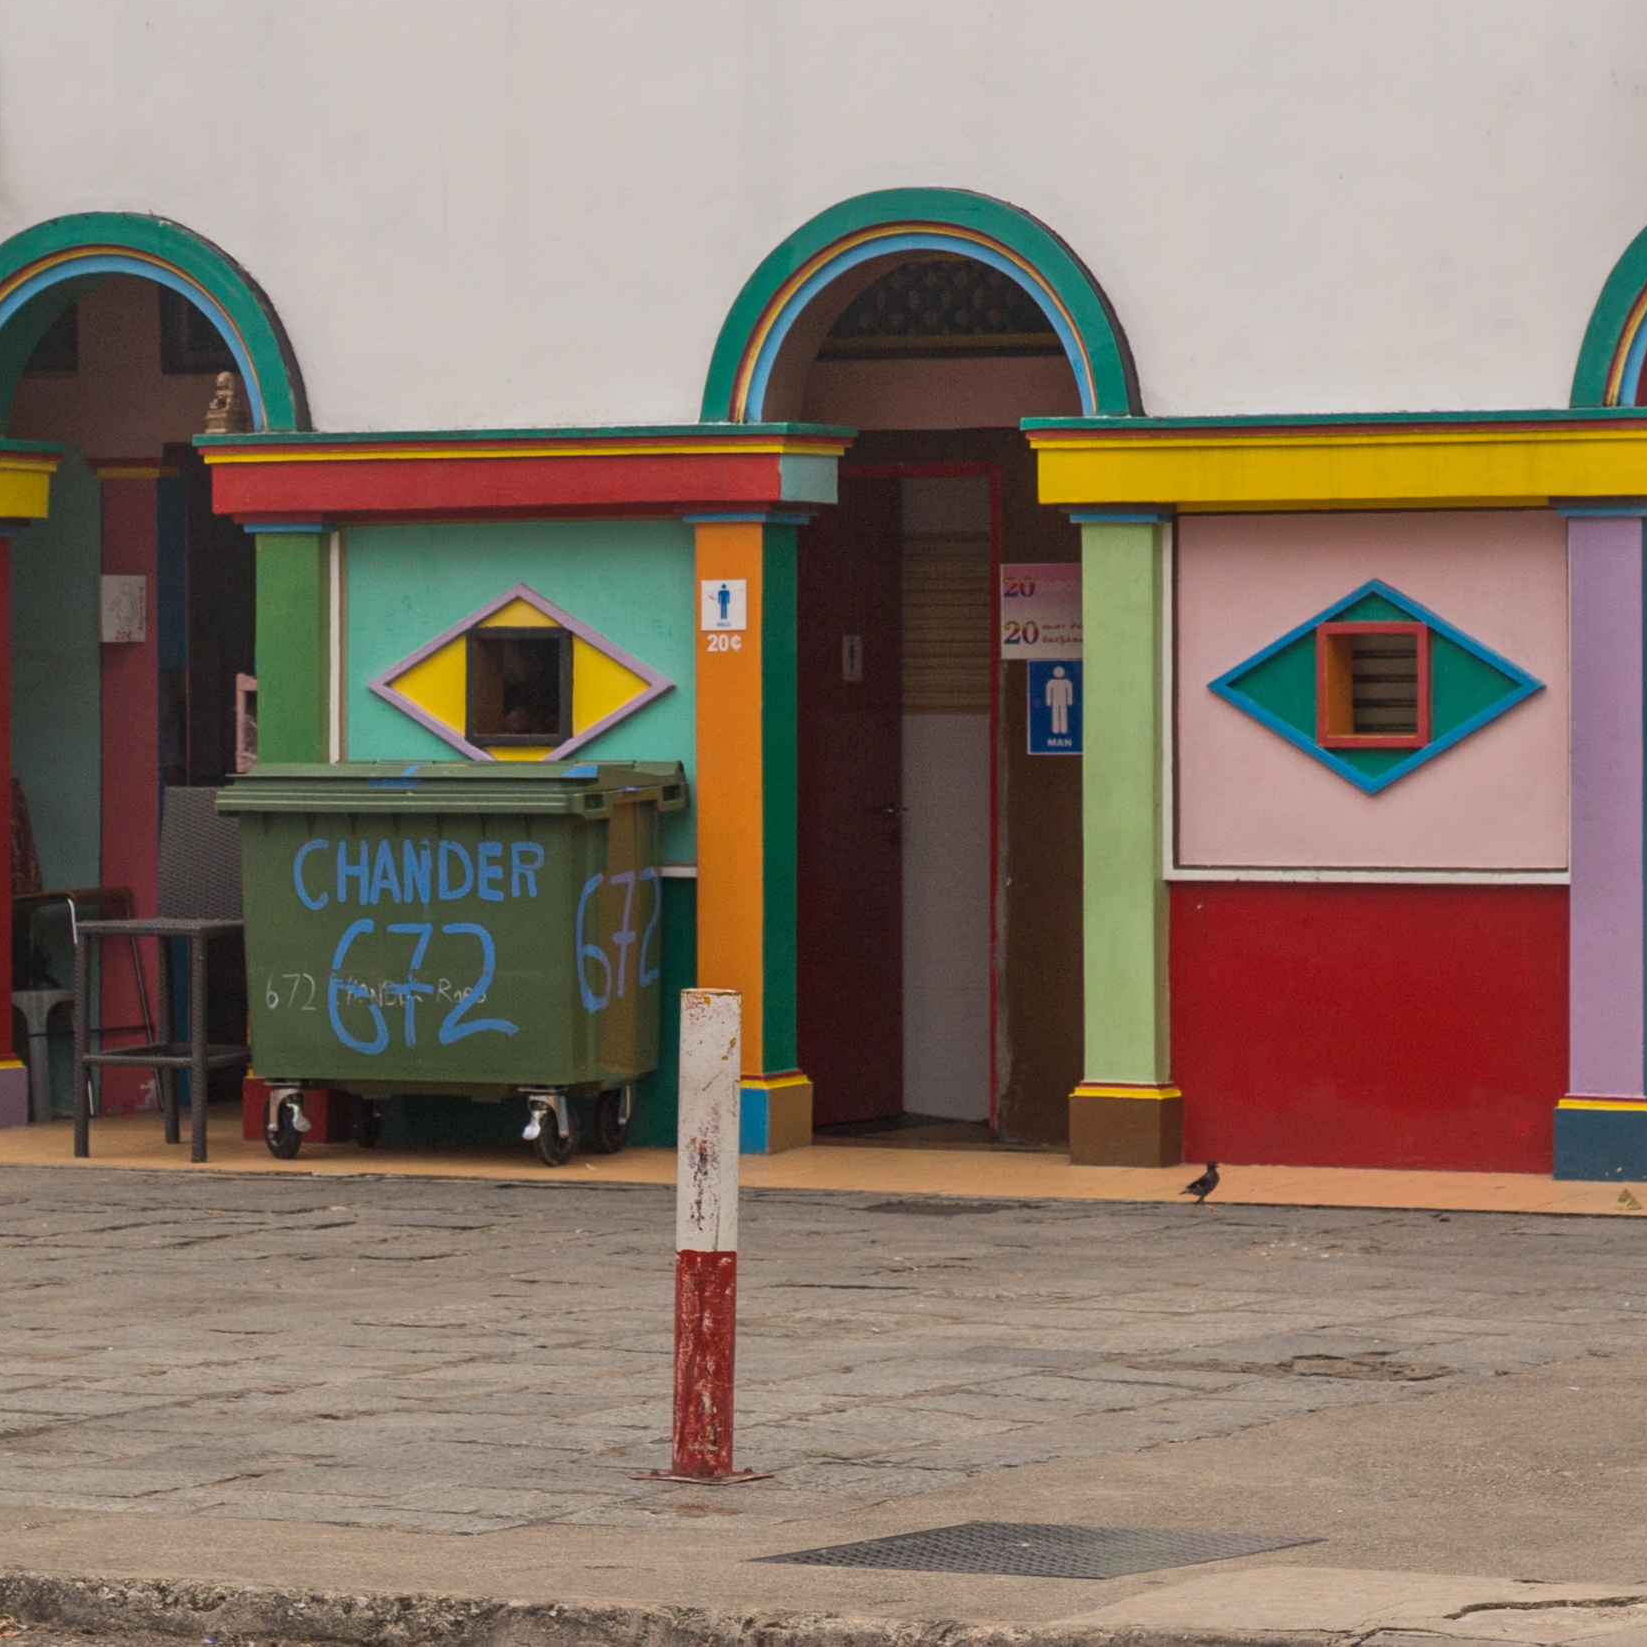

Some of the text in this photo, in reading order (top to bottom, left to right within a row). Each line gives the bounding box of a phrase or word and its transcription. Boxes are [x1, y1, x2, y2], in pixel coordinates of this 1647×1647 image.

[1003, 576, 1036, 598] 20
[1003, 620, 1040, 645] 20
[1046, 738, 1073, 748] MAN
[293, 837, 546, 910] CHANDER
[266, 971, 317, 1010] 672
[327, 918, 519, 1055] 672
